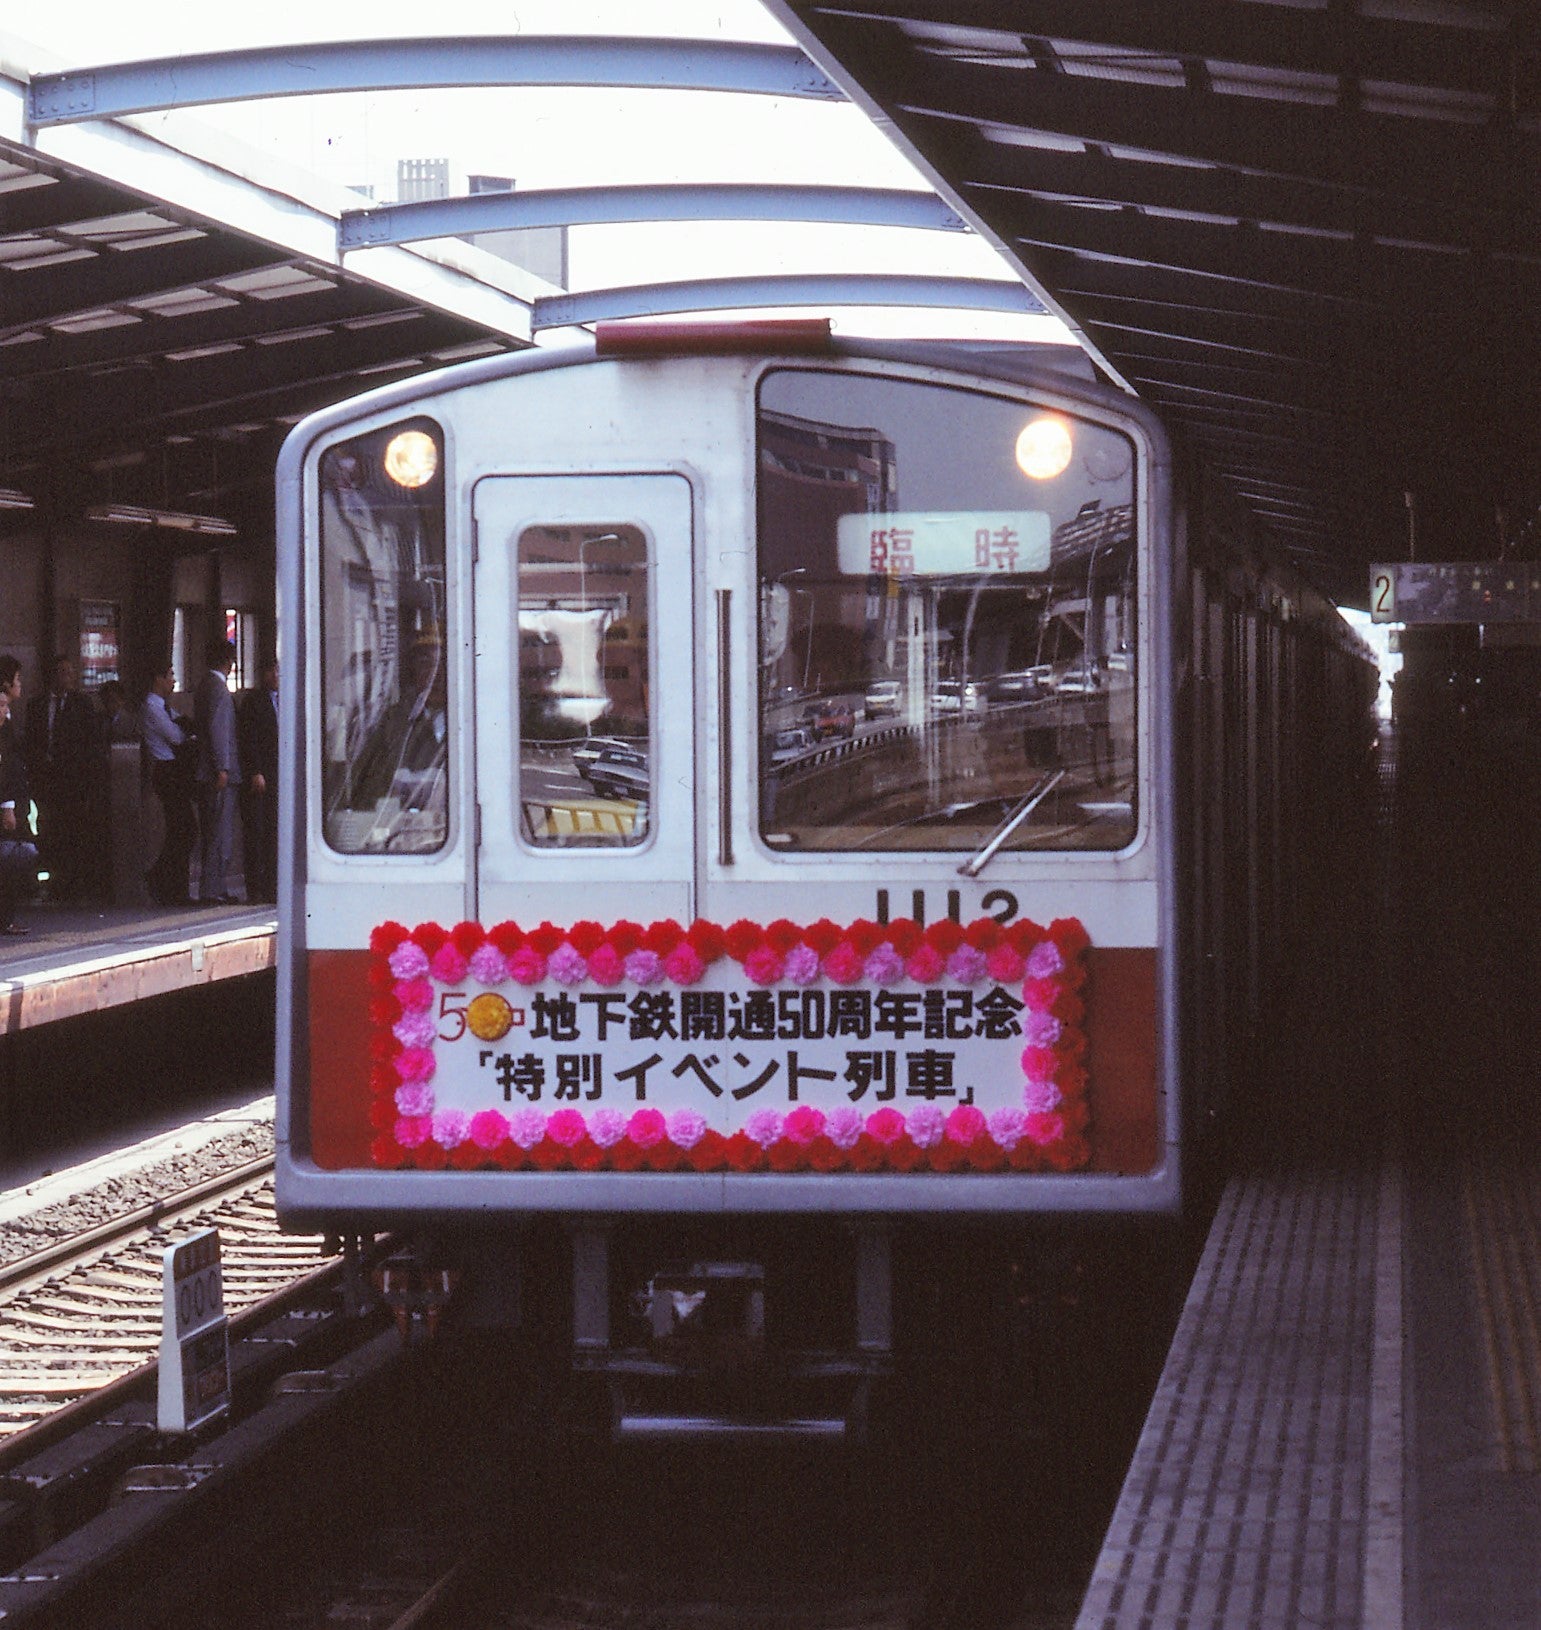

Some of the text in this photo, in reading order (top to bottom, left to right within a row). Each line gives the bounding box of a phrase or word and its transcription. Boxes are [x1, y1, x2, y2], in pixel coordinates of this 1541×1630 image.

[1375, 575, 1391, 613] 2
[530, 988, 1025, 1041] 地下鉄開通50周年記念
[478, 1049, 975, 1106] 「特別イベント列車」
